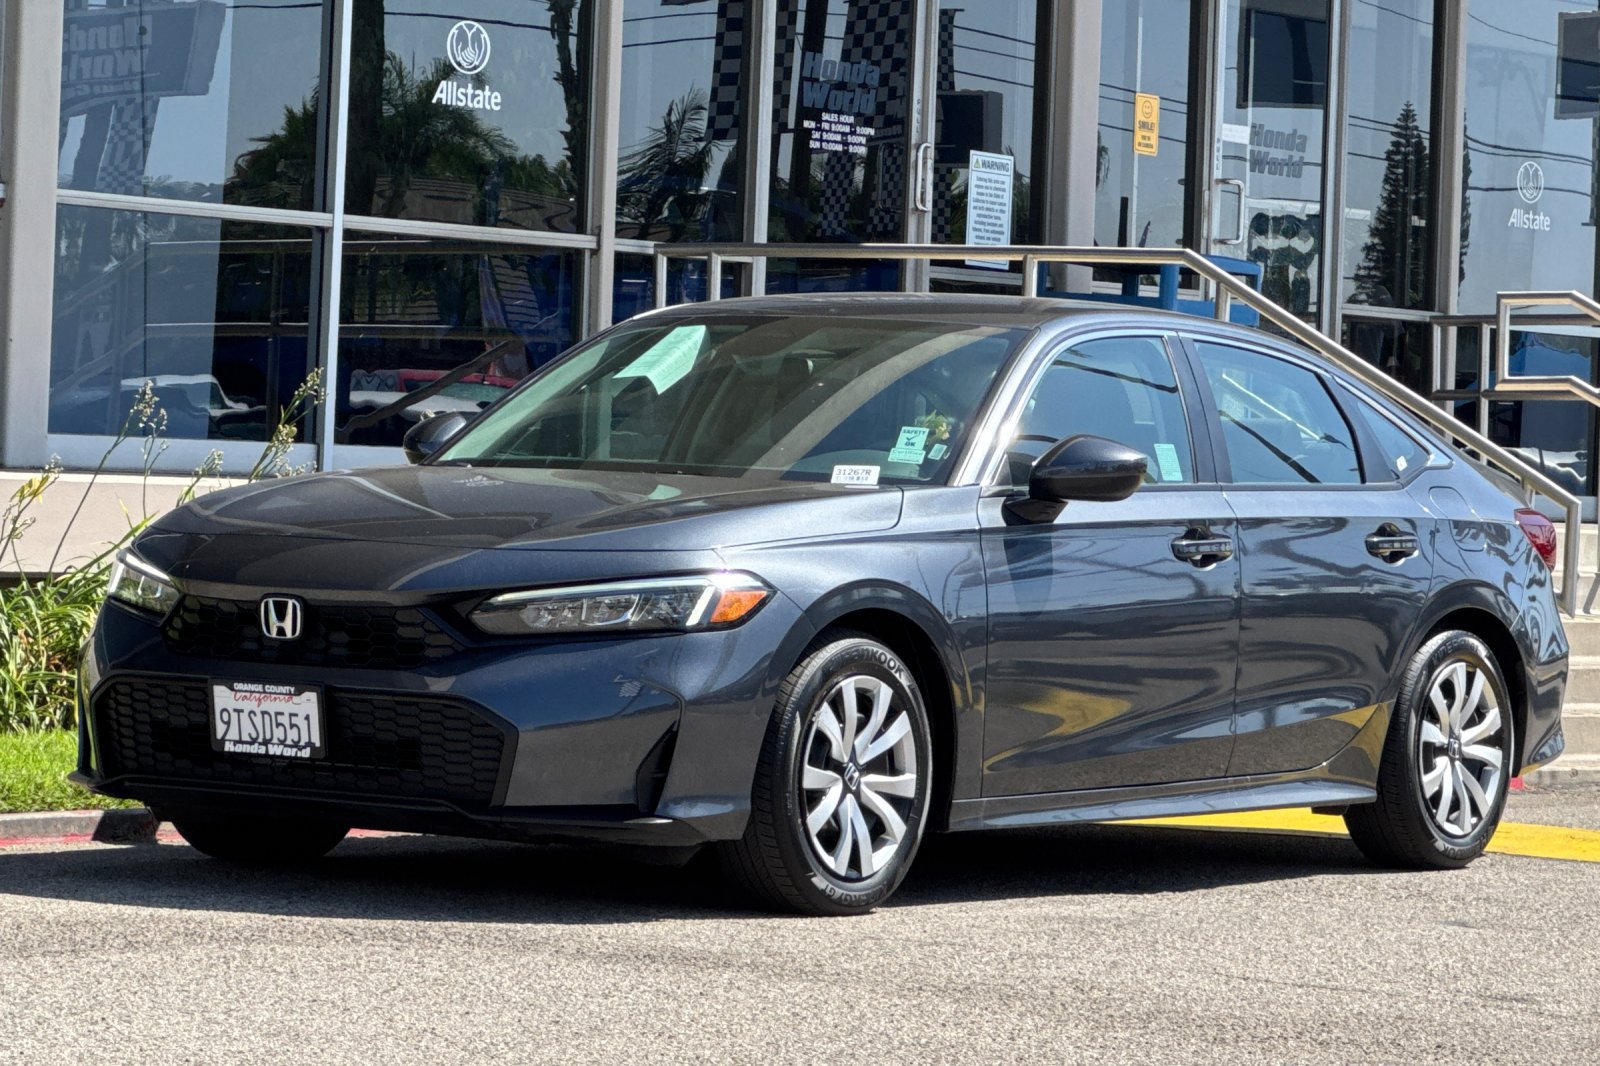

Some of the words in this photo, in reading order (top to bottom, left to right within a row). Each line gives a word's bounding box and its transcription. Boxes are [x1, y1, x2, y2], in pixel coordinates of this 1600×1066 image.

[802, 51, 880, 88] Honda
[431, 80, 501, 111] Allstate
[803, 81, 877, 114] World
[803, 120, 816, 129] MON
[821, 121, 830, 131] FRI
[821, 112, 839, 123] SALES
[809, 140, 820, 149] SUN
[1250, 123, 1307, 153] Honda
[981, 159, 1010, 172] WARNING
[1249, 149, 1304, 178] World
[1508, 208, 1551, 231] Allstate
[233, 682, 263, 692] ORANGE
[265, 684, 295, 694] COUNTY
[233, 691, 302, 708] California
[219, 707, 316, 747] 9TSD551
[224, 740, 266, 754] Honda
[267, 743, 311, 758] World
